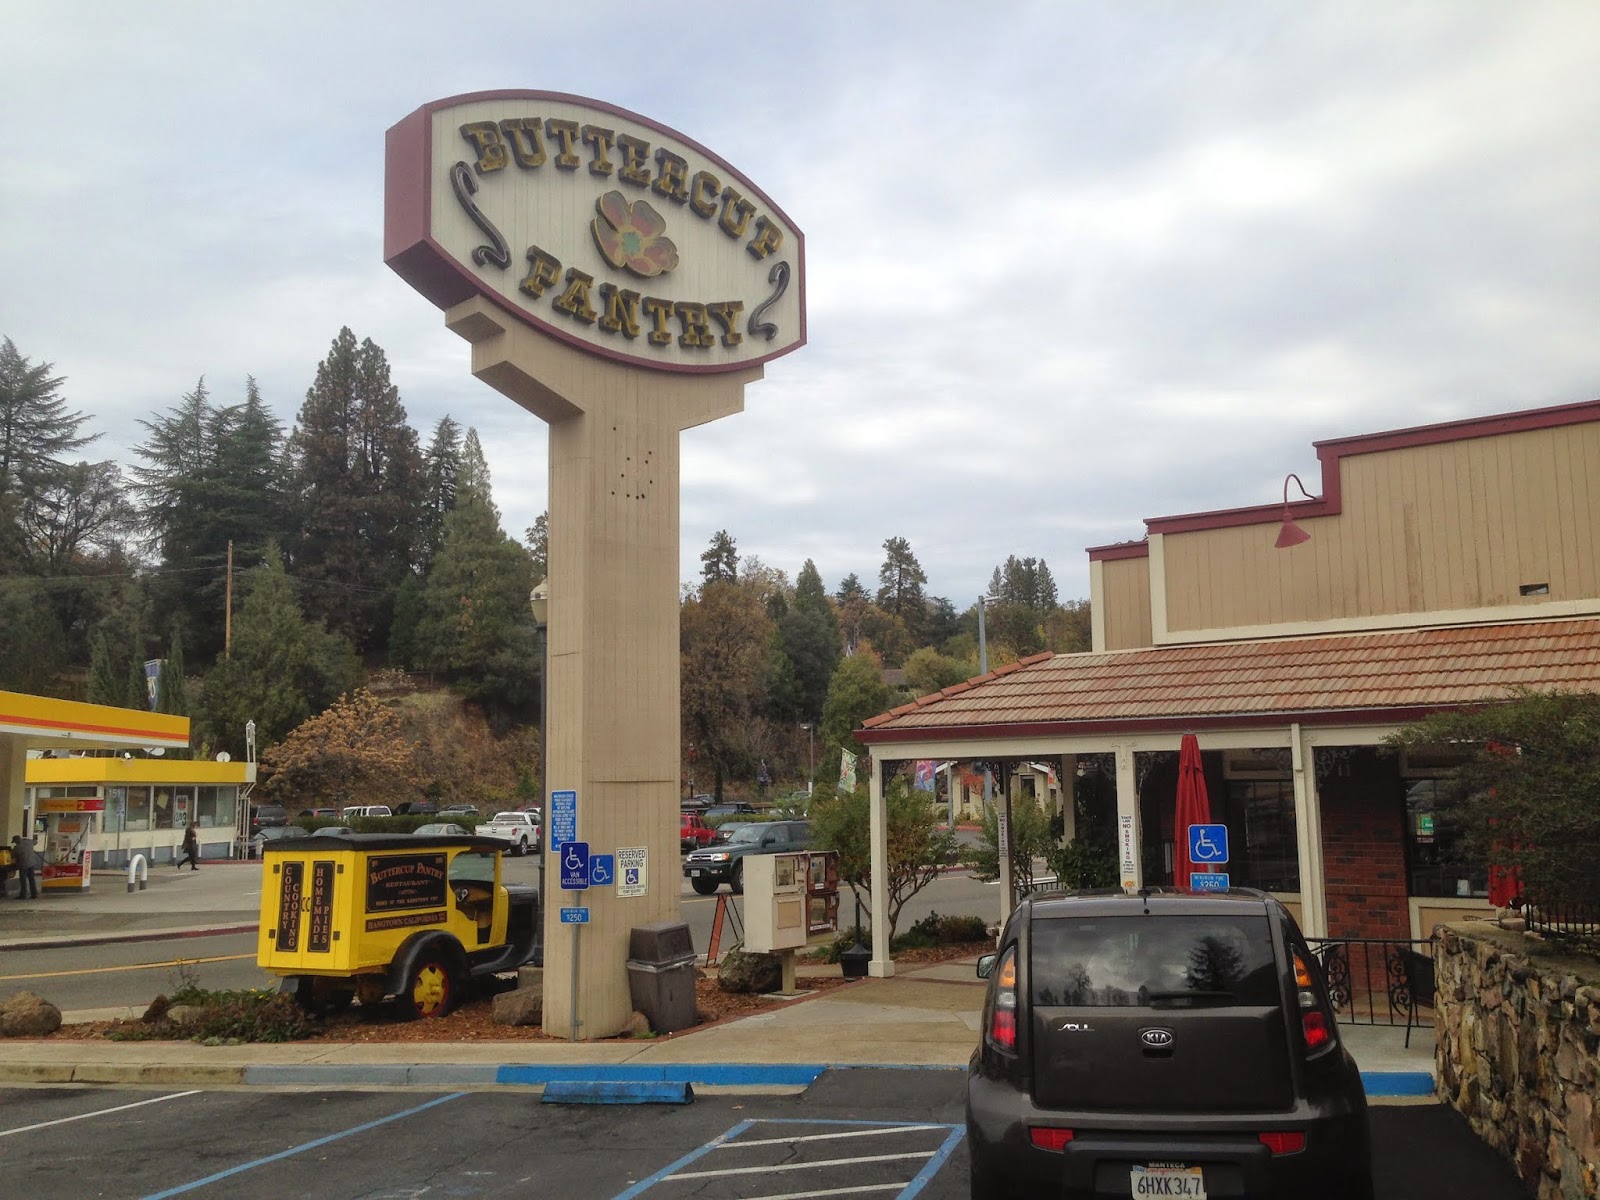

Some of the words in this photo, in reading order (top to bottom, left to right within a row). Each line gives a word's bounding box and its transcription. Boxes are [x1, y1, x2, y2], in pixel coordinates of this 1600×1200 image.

[459, 116, 784, 260] BUTTERCUP
[518, 244, 744, 348] PANTRY
[618, 850, 646, 859] RESERVED
[620, 859, 644, 869] PARKING
[561, 877, 588, 885] ACCESSIBLE
[282, 866, 293, 929] COUNTRY
[312, 868, 324, 944] HOMEMADE
[288, 883, 300, 947] COOKING
[321, 905, 330, 944] PIES
[566, 913, 582, 922] $250
[1146, 1033, 1168, 1042] KIA
[1137, 1176, 1200, 1195] 6HXK347
